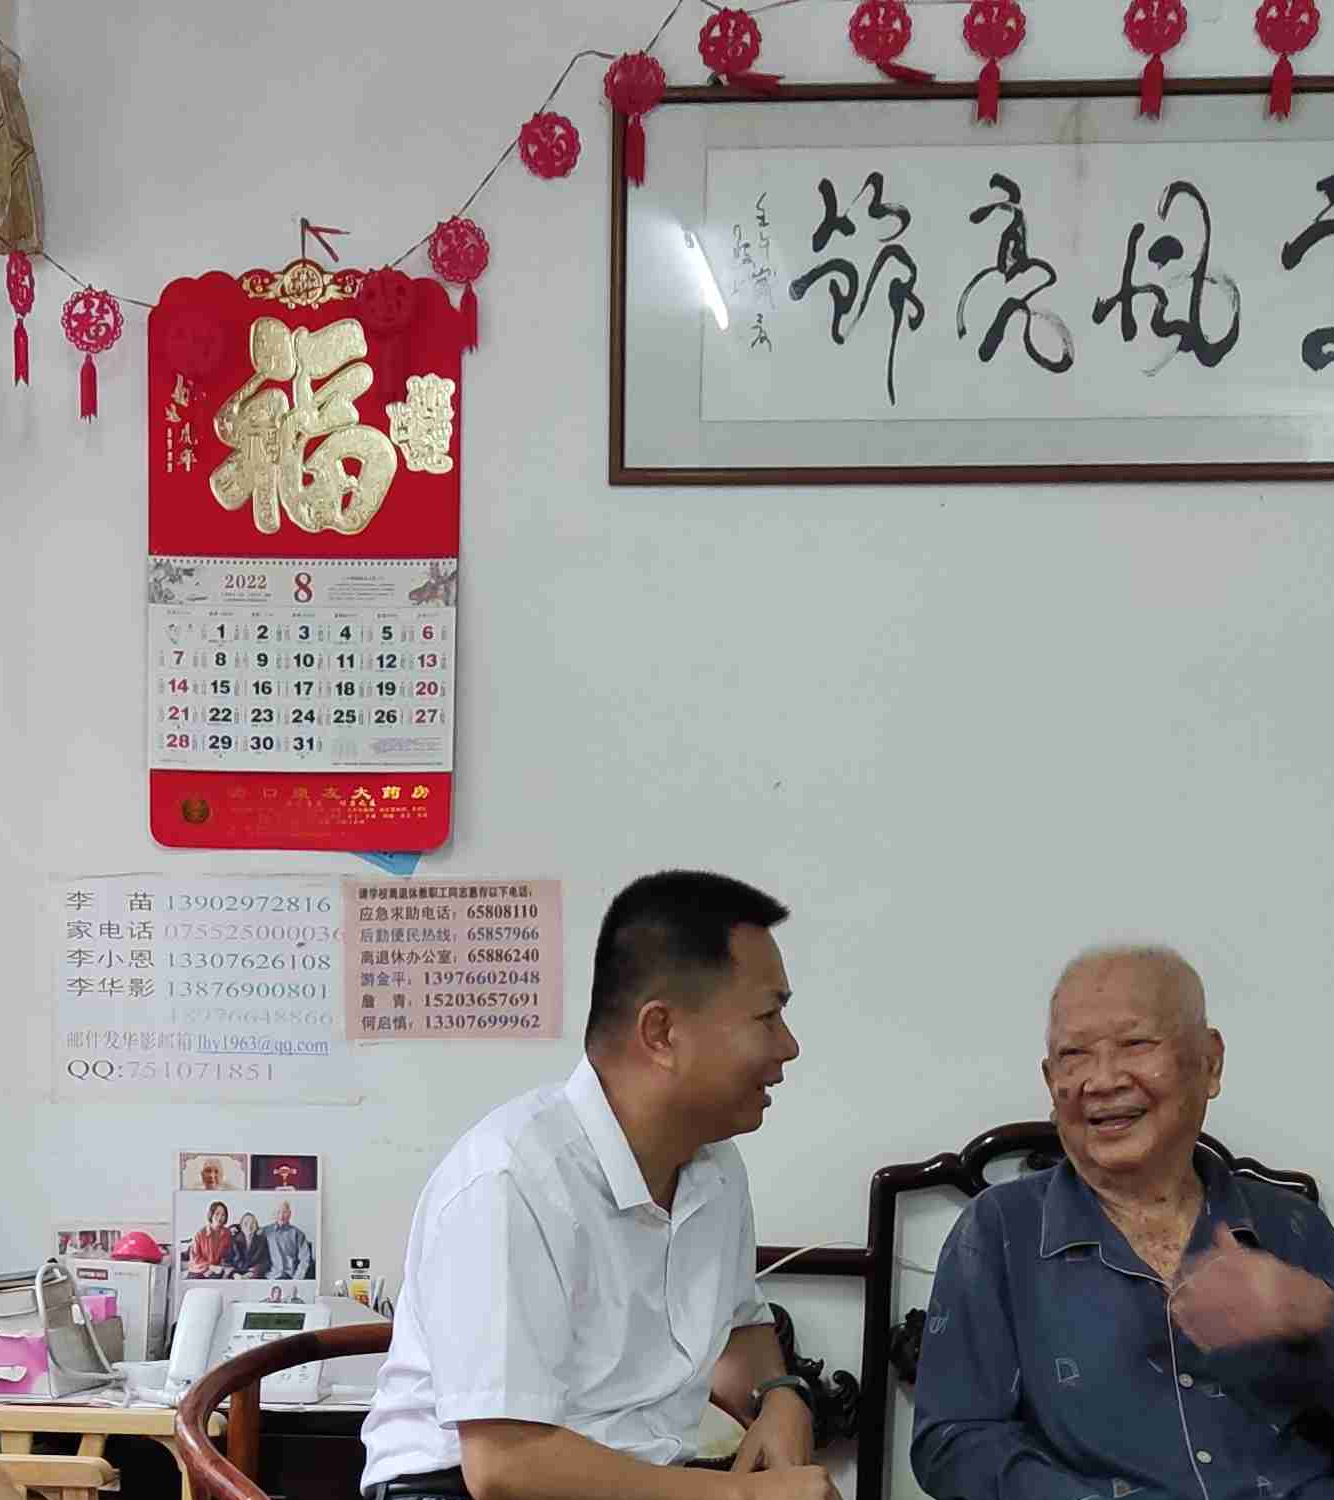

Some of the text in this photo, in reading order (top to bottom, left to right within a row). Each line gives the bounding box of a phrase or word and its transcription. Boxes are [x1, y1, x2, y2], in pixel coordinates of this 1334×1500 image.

[224, 574, 268, 590] 2022
[293, 572, 313, 603] 8
[217, 623, 434, 641] 1 2 3 4 5 6
[173, 650, 437, 669] 7 8 9 10 11 12 13
[168, 678, 439, 697] 14 15 16 17 18 19 20
[169, 705, 438, 724] 21 22 23 24 25 26 27
[166, 734, 314, 751] 28 29 30 31
[66, 891, 331, 912] 李 苗 13902972816
[467, 904, 537, 919] 65808110
[67, 920, 155, 940] 家电话
[467, 927, 539, 942] 65857966
[167, 953, 331, 970] 13307626108
[468, 949, 539, 963] 65886240
[424, 971, 540, 985] 13976602048
[67, 978, 329, 999] 李华影 13876900801
[424, 993, 538, 1007] 15203657691
[425, 1015, 540, 1029] 13307699962
